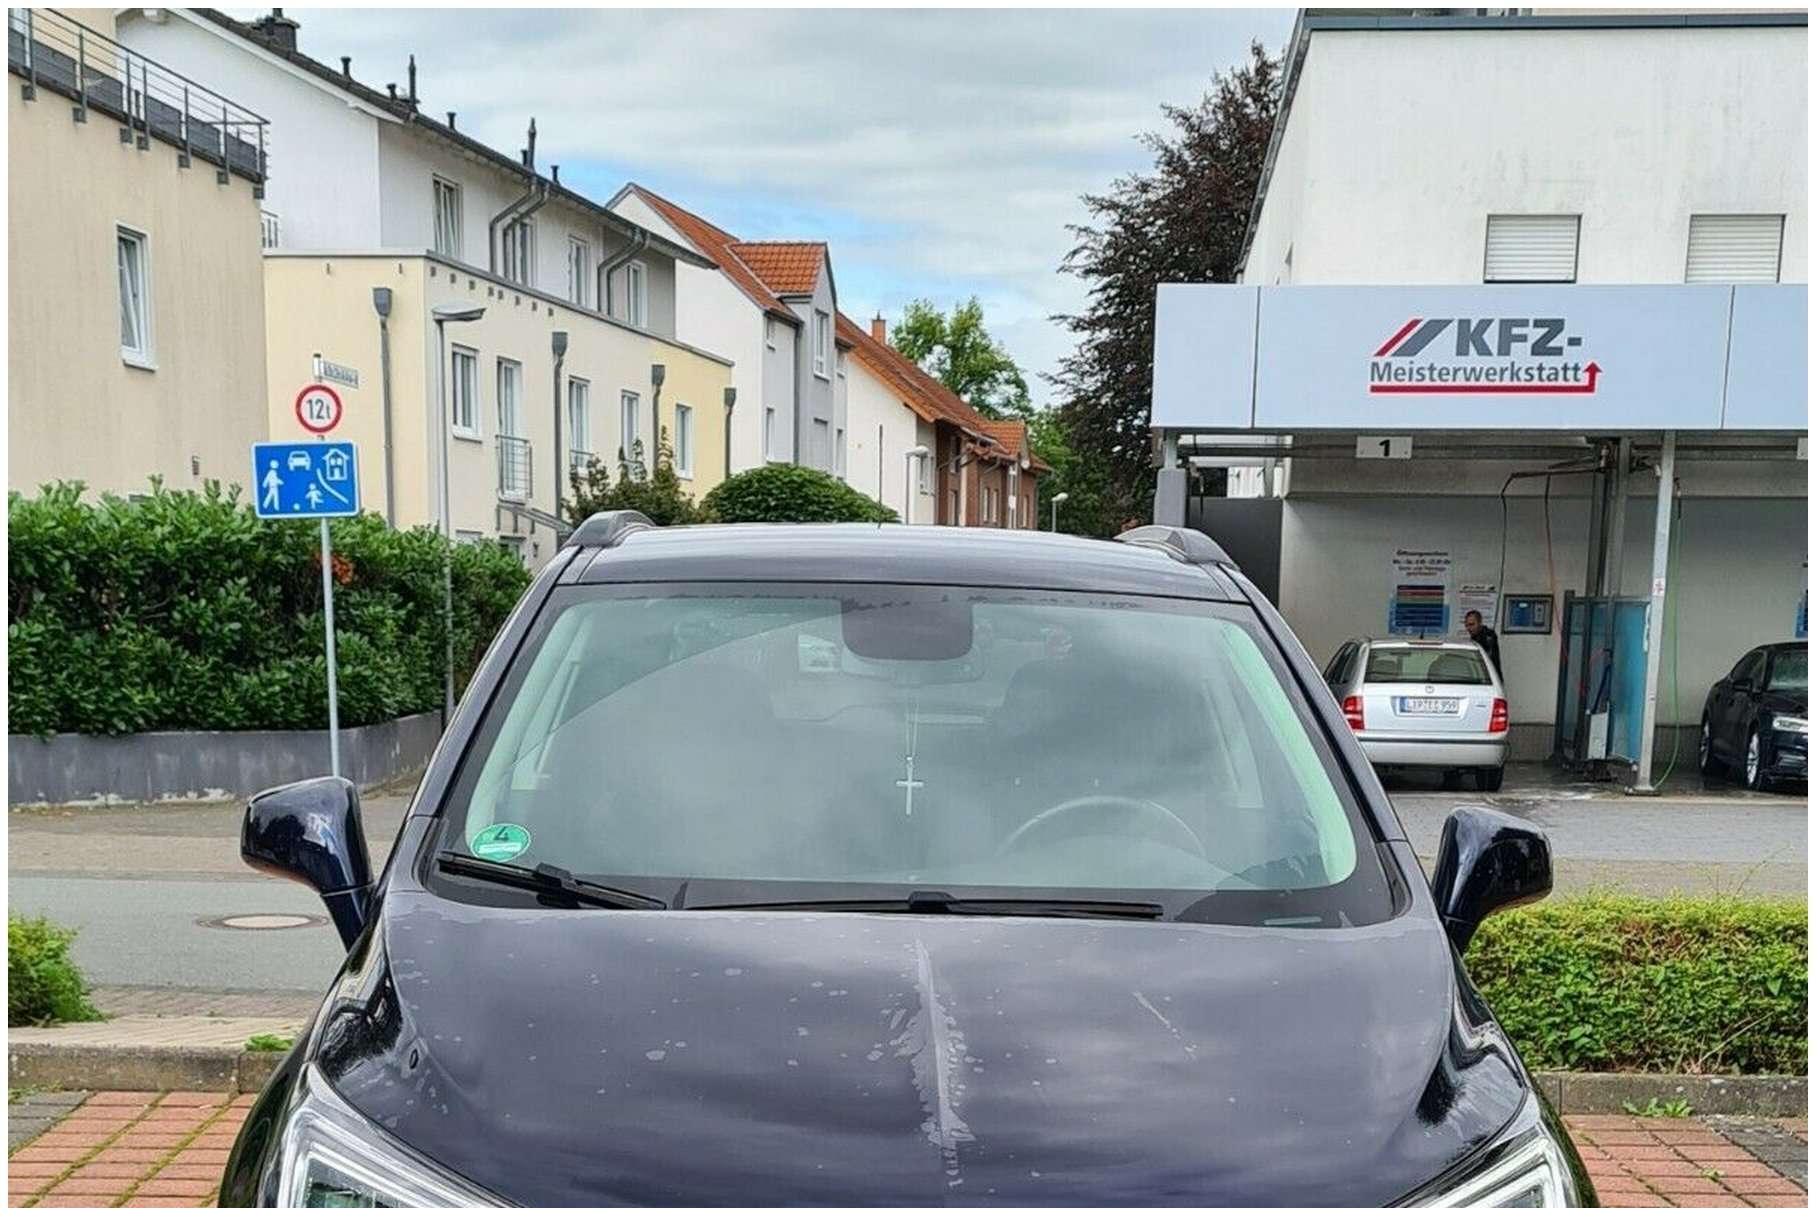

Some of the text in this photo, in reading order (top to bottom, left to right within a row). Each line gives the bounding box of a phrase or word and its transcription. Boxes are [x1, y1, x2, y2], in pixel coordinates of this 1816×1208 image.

[1455, 318, 1583, 357] KFZ-
[1369, 360, 1582, 383] Meisterwerkstatt
[1379, 439, 1391, 457] 1
[493, 826, 509, 841] 4
